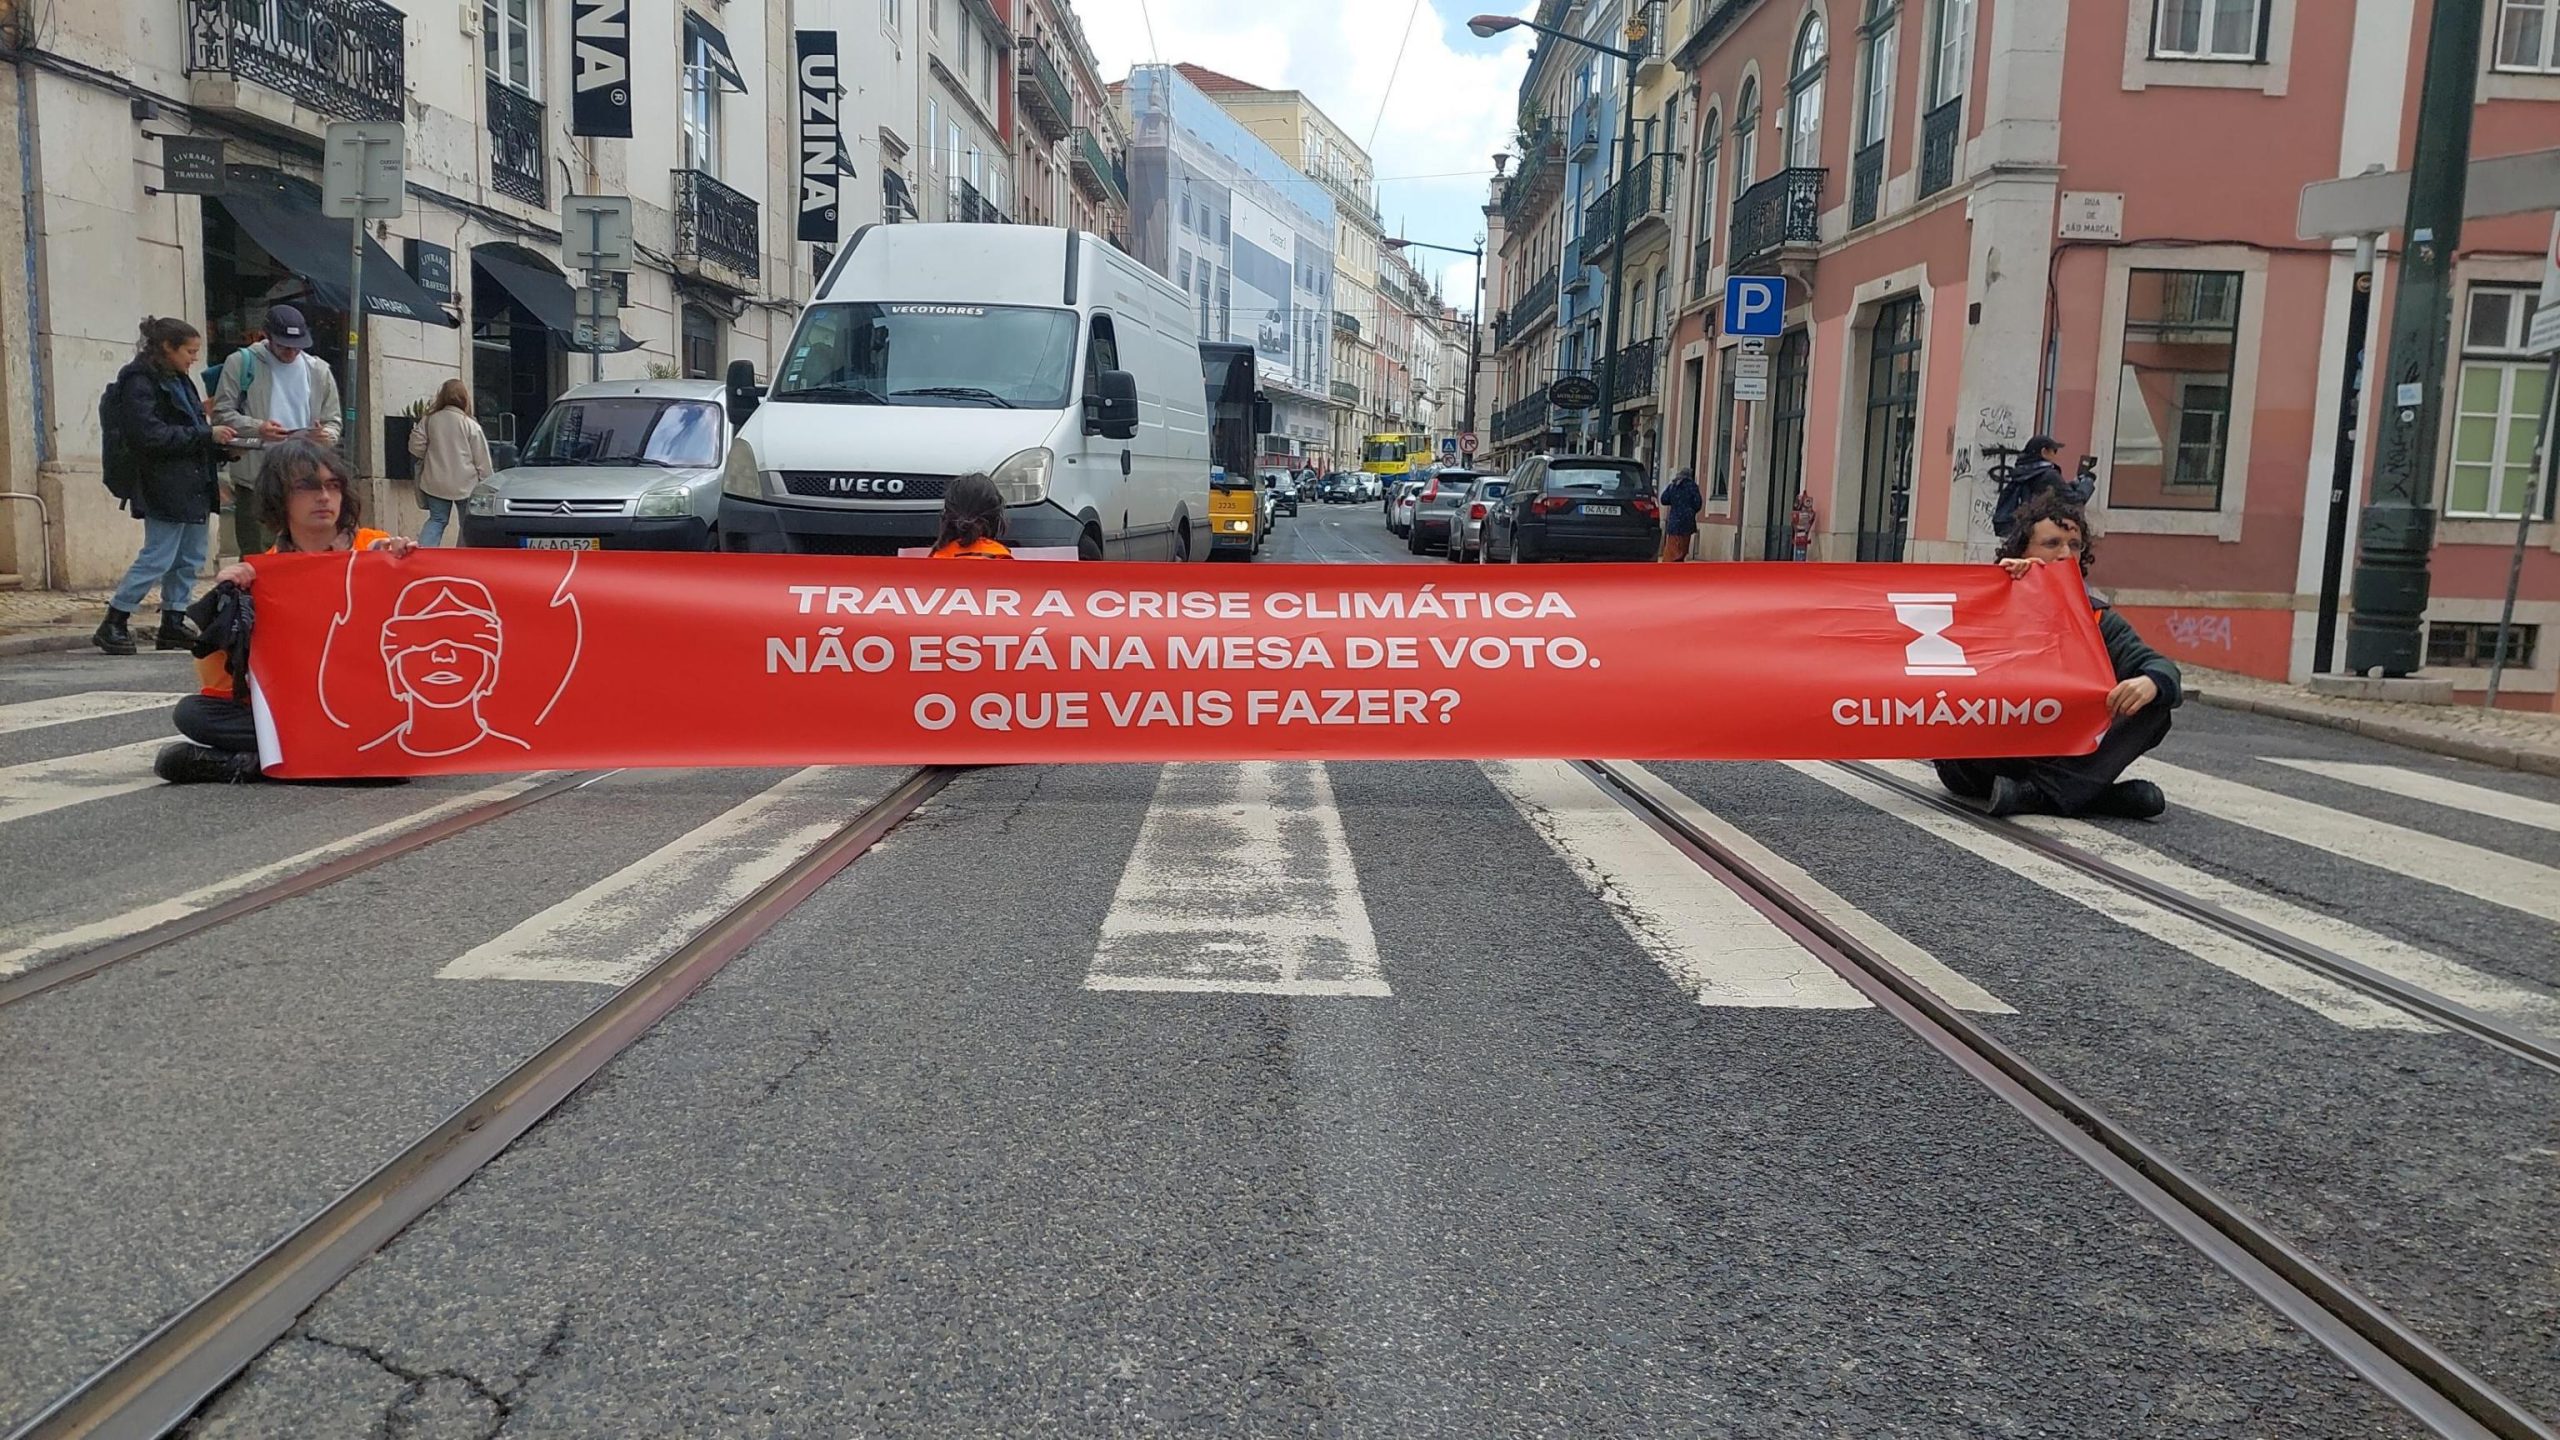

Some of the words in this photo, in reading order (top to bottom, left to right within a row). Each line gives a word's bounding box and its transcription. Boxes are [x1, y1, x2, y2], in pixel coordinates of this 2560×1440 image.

[800, 54, 836, 212] UZINA
[173, 152, 215, 165] LIVRARIA
[174, 171, 214, 179] TRAVESSA
[2084, 198, 2100, 206] RUA
[421, 253, 449, 272] LIVRARIA
[421, 278, 449, 293] TRAVESSA
[365, 295, 416, 316] LIVRARIA
[891, 306, 985, 316] VECOTORRES
[1737, 283, 1771, 330] P
[1980, 418, 2017, 439] ACAB
[829, 478, 904, 493] IVECO
[789, 586, 1021, 616] TRAVAR
[1031, 590, 1074, 617] A
[1085, 590, 1251, 619] CRISE
[1263, 584, 1576, 619] CLIMÁTICA
[766, 626, 895, 673] NÃO
[909, 627, 1057, 671] ESTÁ
[1070, 636, 1155, 670] NA
[1167, 636, 1334, 669] MESA
[1345, 637, 1419, 669] DE
[1428, 636, 1601, 669] VOTO.
[914, 693, 956, 730] O
[970, 692, 1089, 731] QUE
[1100, 691, 1233, 728] VAIS
[1247, 688, 1461, 725] FAZER?
[1832, 690, 2062, 726] CLIMÁXIMO
